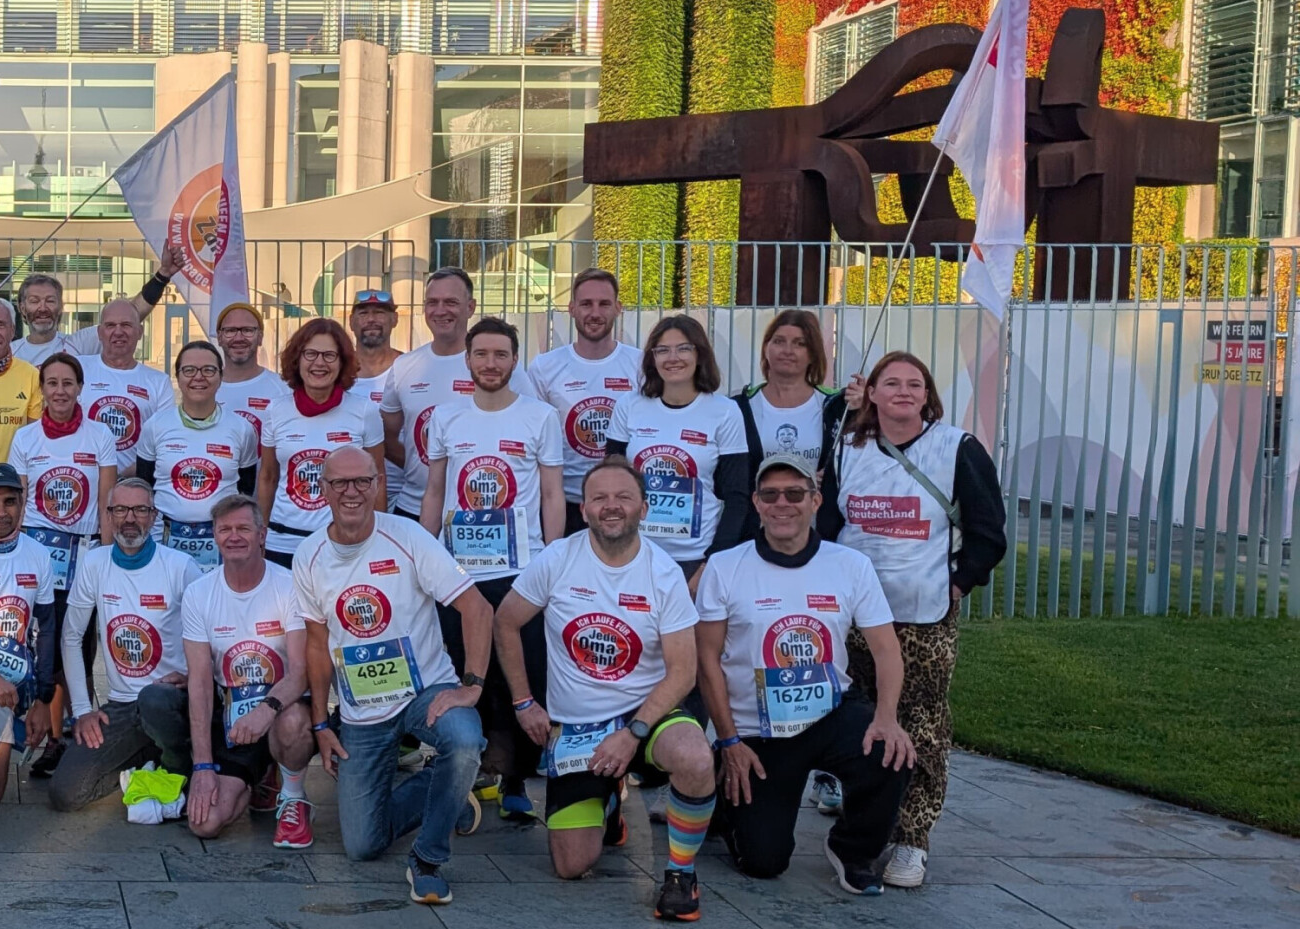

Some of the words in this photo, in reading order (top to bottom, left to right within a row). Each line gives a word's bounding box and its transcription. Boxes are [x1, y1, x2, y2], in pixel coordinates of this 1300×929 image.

[1212, 325, 1230, 336] WR
[101, 413, 125, 425] Oma
[580, 419, 609, 431] Oma
[640, 450, 653, 459] ICH
[654, 446, 675, 455] LAUFE
[653, 459, 676, 469] Jede
[477, 471, 497, 481] Jede
[470, 480, 497, 493] Oma
[47, 489, 73, 500] Oma
[848, 509, 916, 519] Deutschland
[457, 527, 501, 540] 83641
[172, 539, 213, 551] 76876
[348, 604, 373, 615] Oma
[576, 617, 590, 628] ICH
[591, 616, 615, 626] LAUFE
[773, 625, 784, 634] ICH
[784, 617, 807, 627] LAUFE
[121, 629, 140, 638] Jede
[588, 629, 617, 642] Jede
[787, 632, 812, 643] Jede
[115, 636, 141, 650] Oma
[579, 636, 616, 655] Oma
[780, 642, 813, 657] Oma
[235, 666, 262, 677] Oma
[357, 661, 397, 679] 4822
[384, 693, 400, 702] THIS
[773, 685, 824, 703] 16270
[794, 704, 808, 712] Jörg
[773, 724, 785, 733] YOU
[788, 723, 800, 732] GOT
[570, 759, 584, 767] GOT
